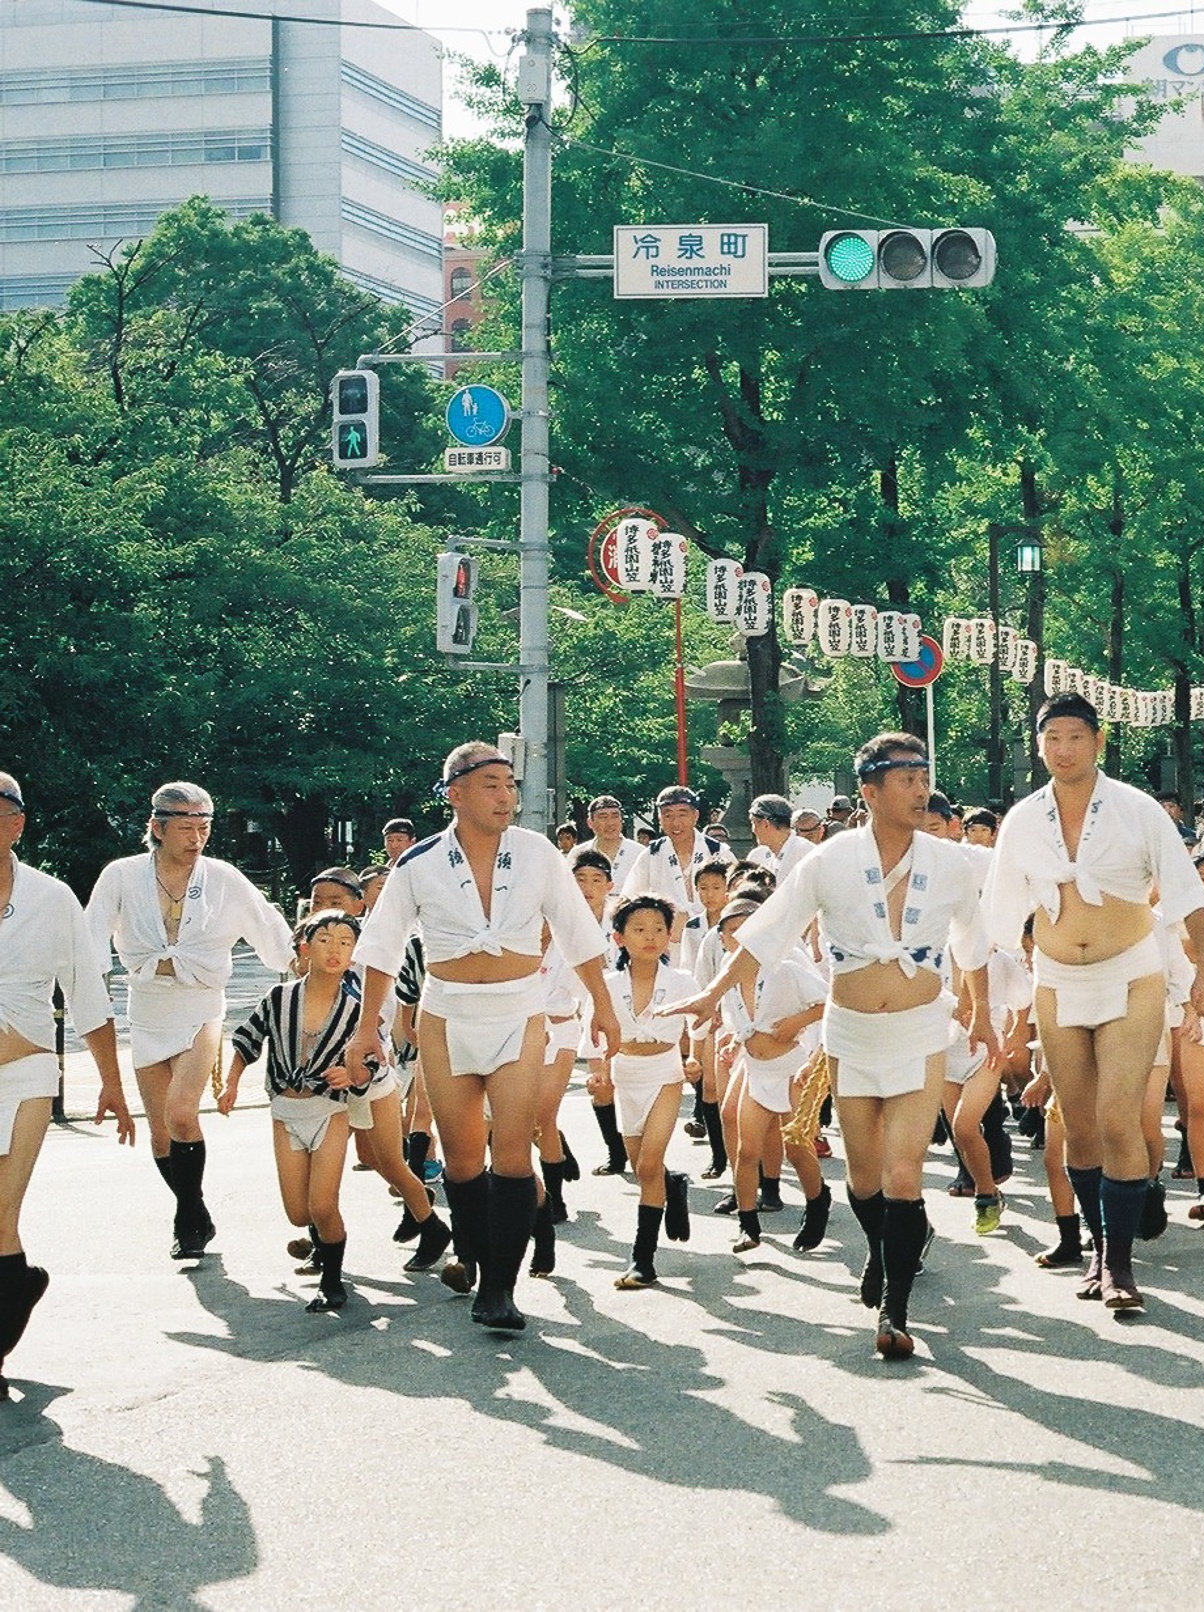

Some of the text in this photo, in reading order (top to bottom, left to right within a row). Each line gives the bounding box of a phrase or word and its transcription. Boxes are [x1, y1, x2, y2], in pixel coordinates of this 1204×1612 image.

[632, 233, 748, 260] 冷泉町
[650, 264, 731, 277] Reisenmachi
[654, 279, 728, 290] INTERSECTION
[448, 452, 502, 466] 自転車通行可
